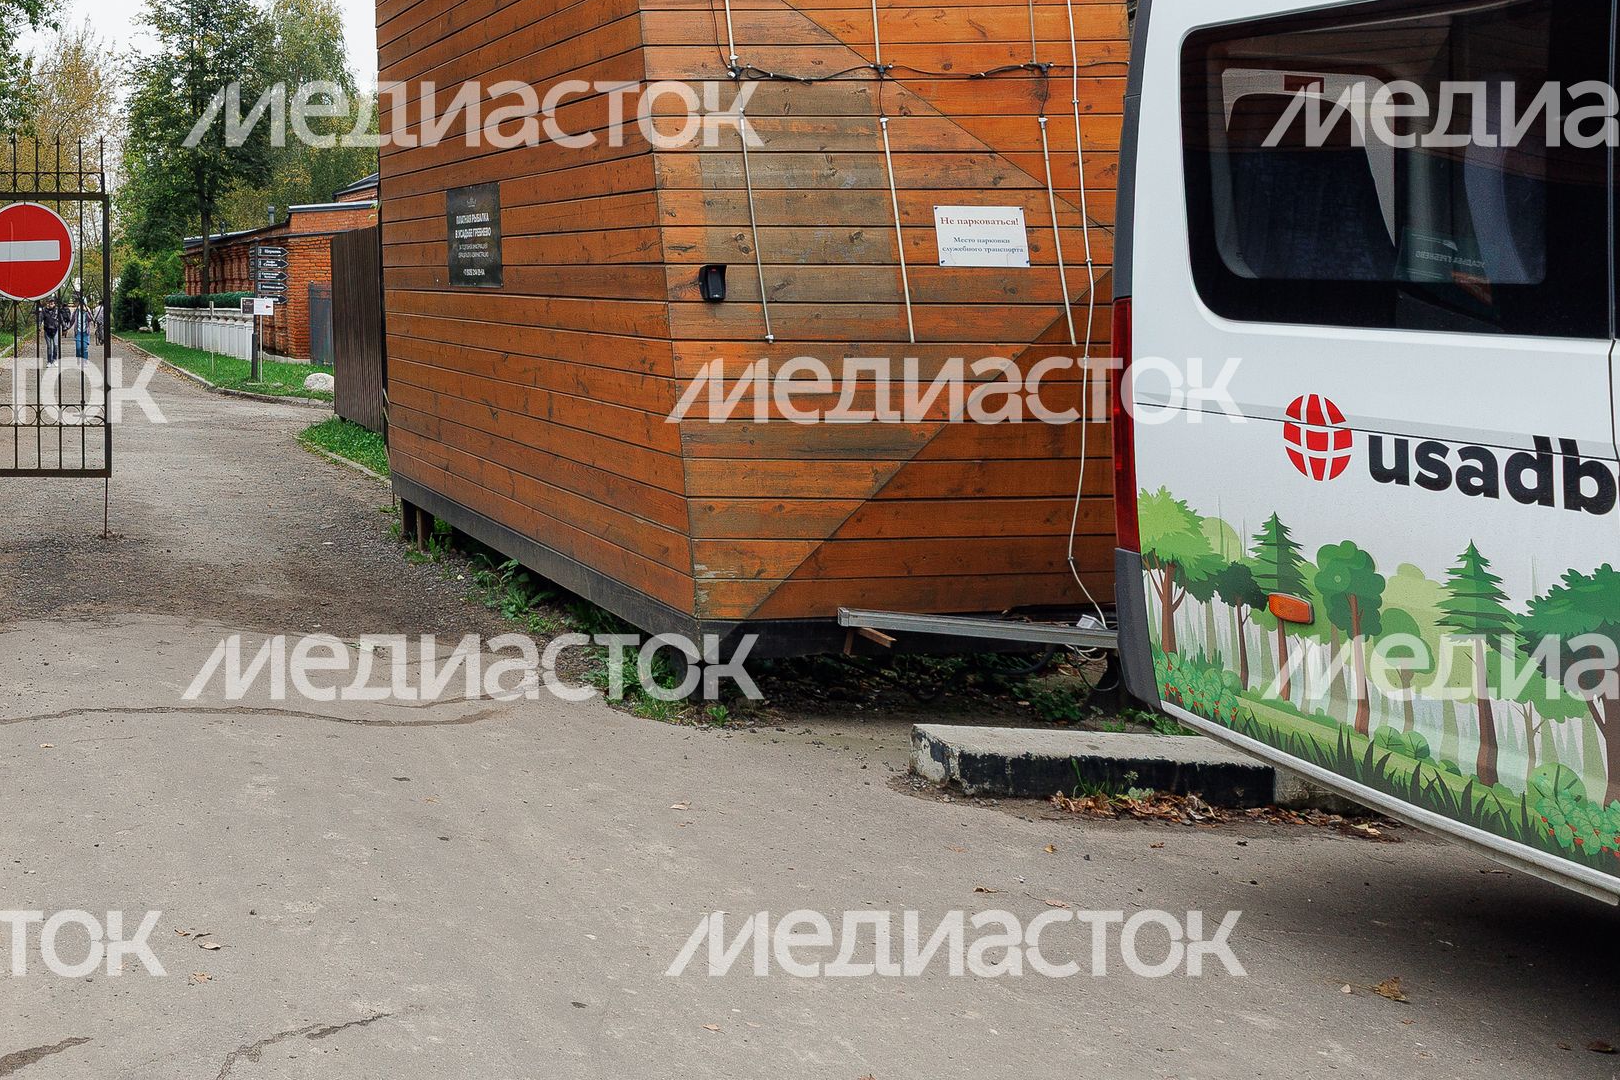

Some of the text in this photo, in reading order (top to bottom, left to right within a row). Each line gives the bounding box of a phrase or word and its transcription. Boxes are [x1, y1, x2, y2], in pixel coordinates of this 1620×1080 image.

[940, 217, 1019, 227] Не парковаться!
[1368, 434, 1620, 516] usadb
